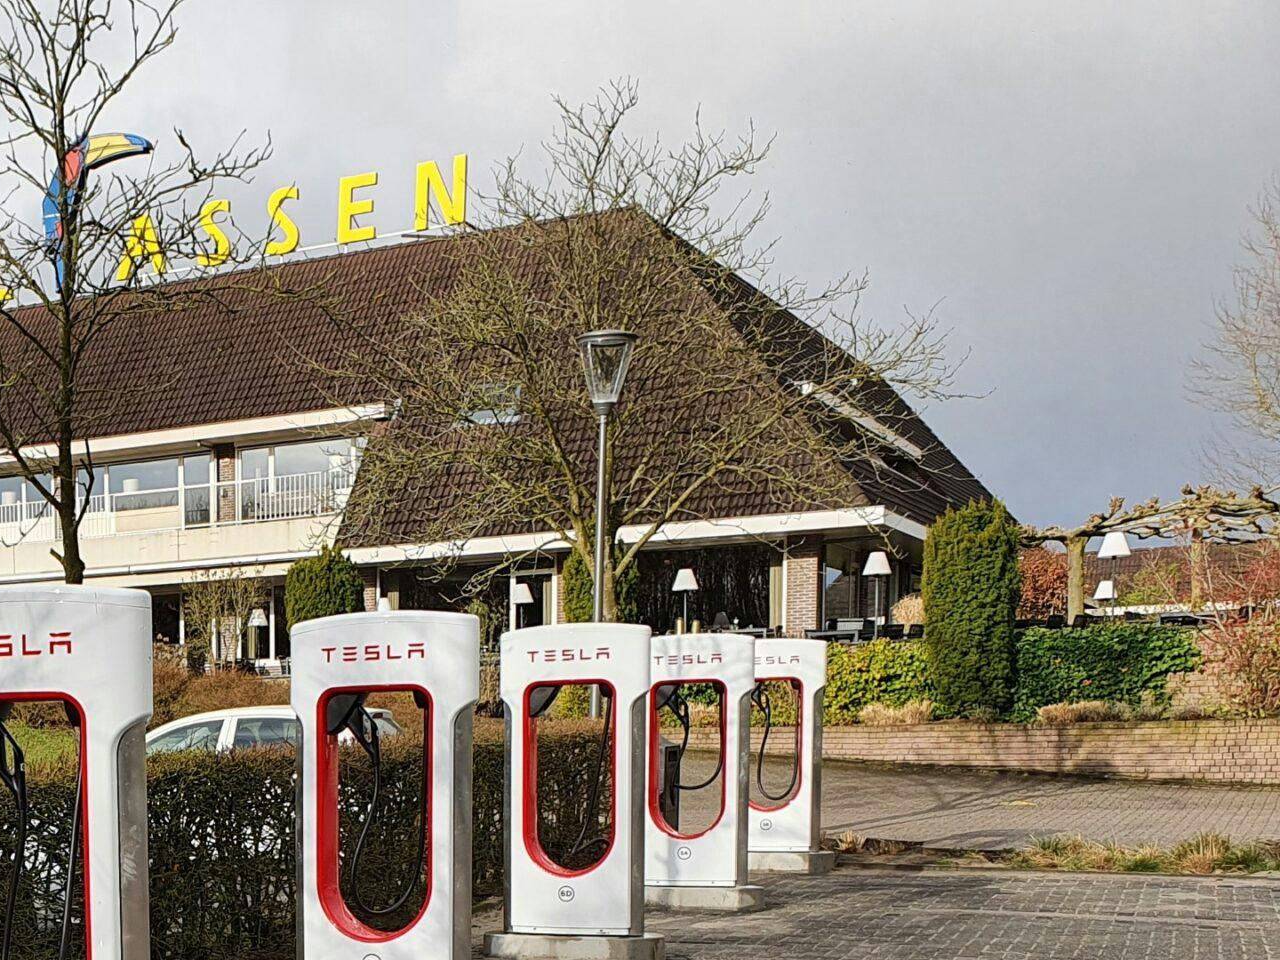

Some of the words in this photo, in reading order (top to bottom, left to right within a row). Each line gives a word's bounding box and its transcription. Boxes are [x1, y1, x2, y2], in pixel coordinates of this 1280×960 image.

[116, 153, 468, 281] ASSEN
[321, 643, 424, 663] TESLA
[526, 647, 610, 663] TESLA
[653, 653, 722, 665] TESLA
[754, 655, 800, 665] ESLA
